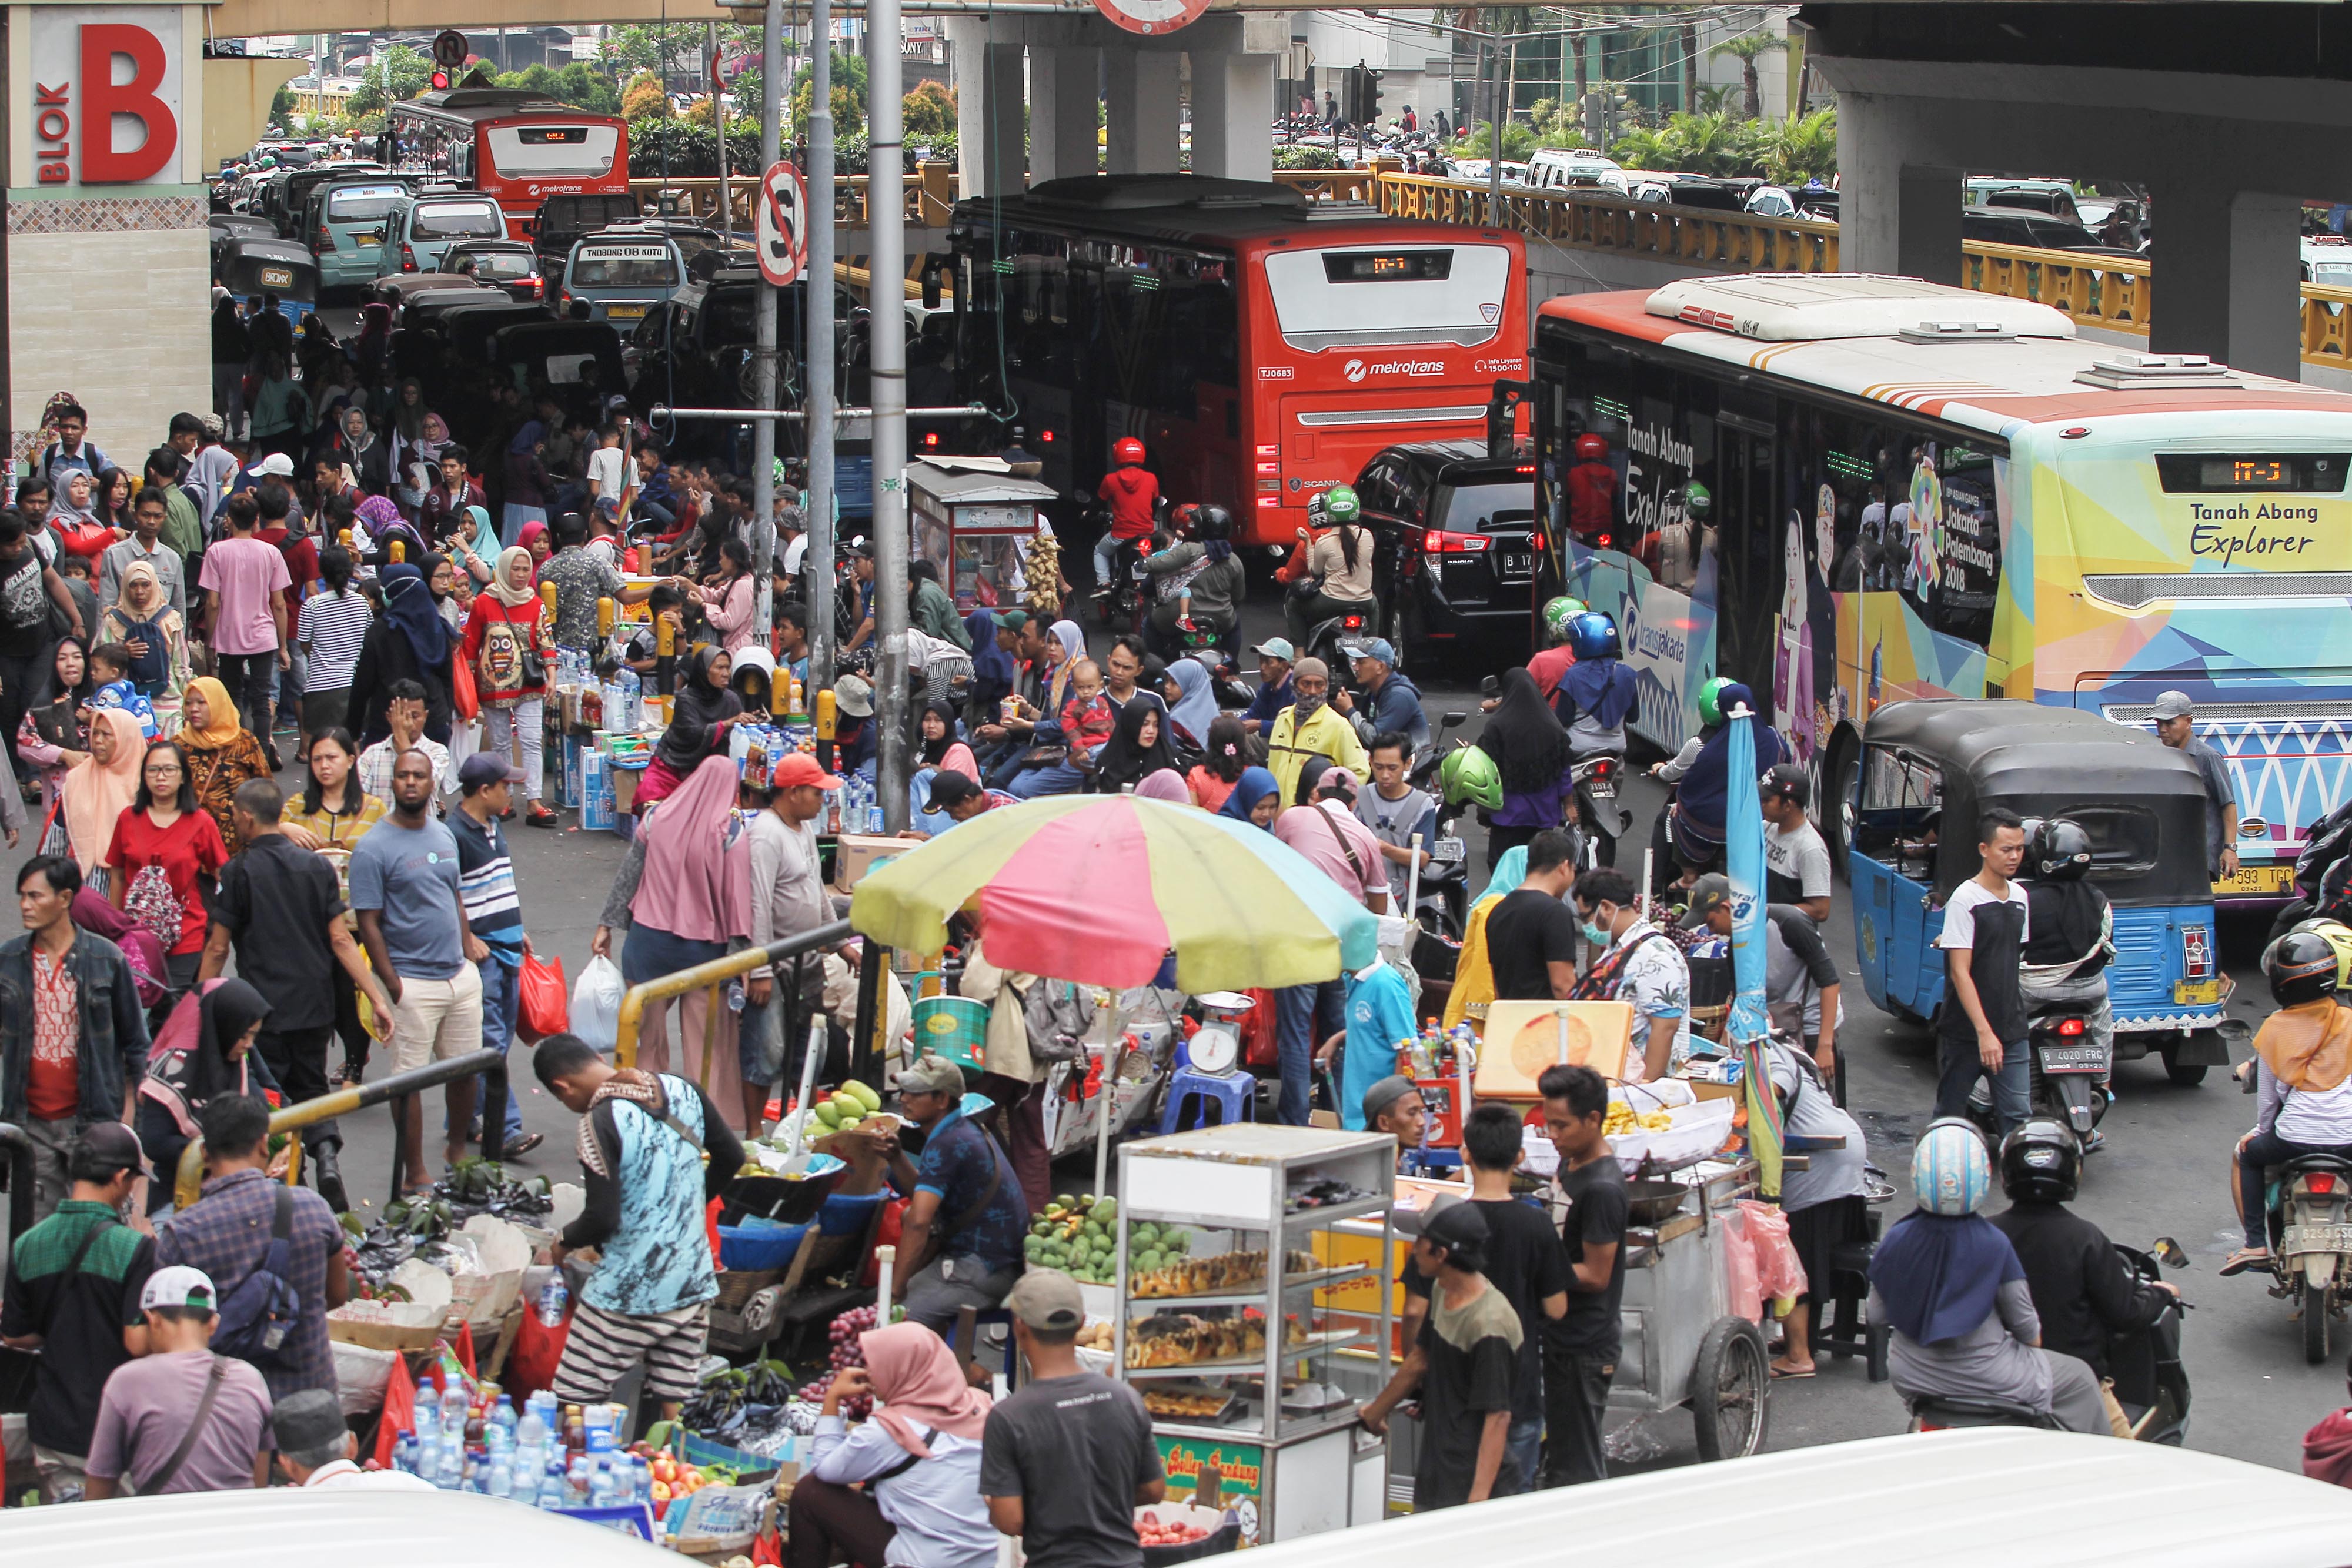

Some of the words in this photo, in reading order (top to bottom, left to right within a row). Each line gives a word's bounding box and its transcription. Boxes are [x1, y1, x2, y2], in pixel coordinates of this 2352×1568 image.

[38, 81, 70, 182] BLOK
[80, 24, 178, 183] B
[542, 185, 582, 194] metrotrans
[1261, 369, 1292, 377] TJ0683
[1369, 360, 1445, 376] metrotrans
[1489, 364, 1522, 372] 1500-102
[1626, 414, 1656, 457] Tanah
[1659, 426, 1693, 478] Abang
[1304, 480, 1341, 488] SCANIA
[1953, 489, 1965, 502] ASIAN
[1965, 493, 1980, 507] GAMES
[1946, 504, 1980, 536] Jakarta
[2190, 503, 2249, 520] Tanah
[2256, 502, 2318, 524] Abang
[1945, 531, 1993, 577] Palembang
[2190, 523, 2316, 569] Explorer
[1508, 556, 1514, 567] B
[1945, 563, 1965, 592] 2018
[1639, 618, 1684, 663] transjakarta
[2044, 1052, 2050, 1061] B
[2057, 1051, 2080, 1061] 4020
[2085, 1049, 2103, 1060] FRG
